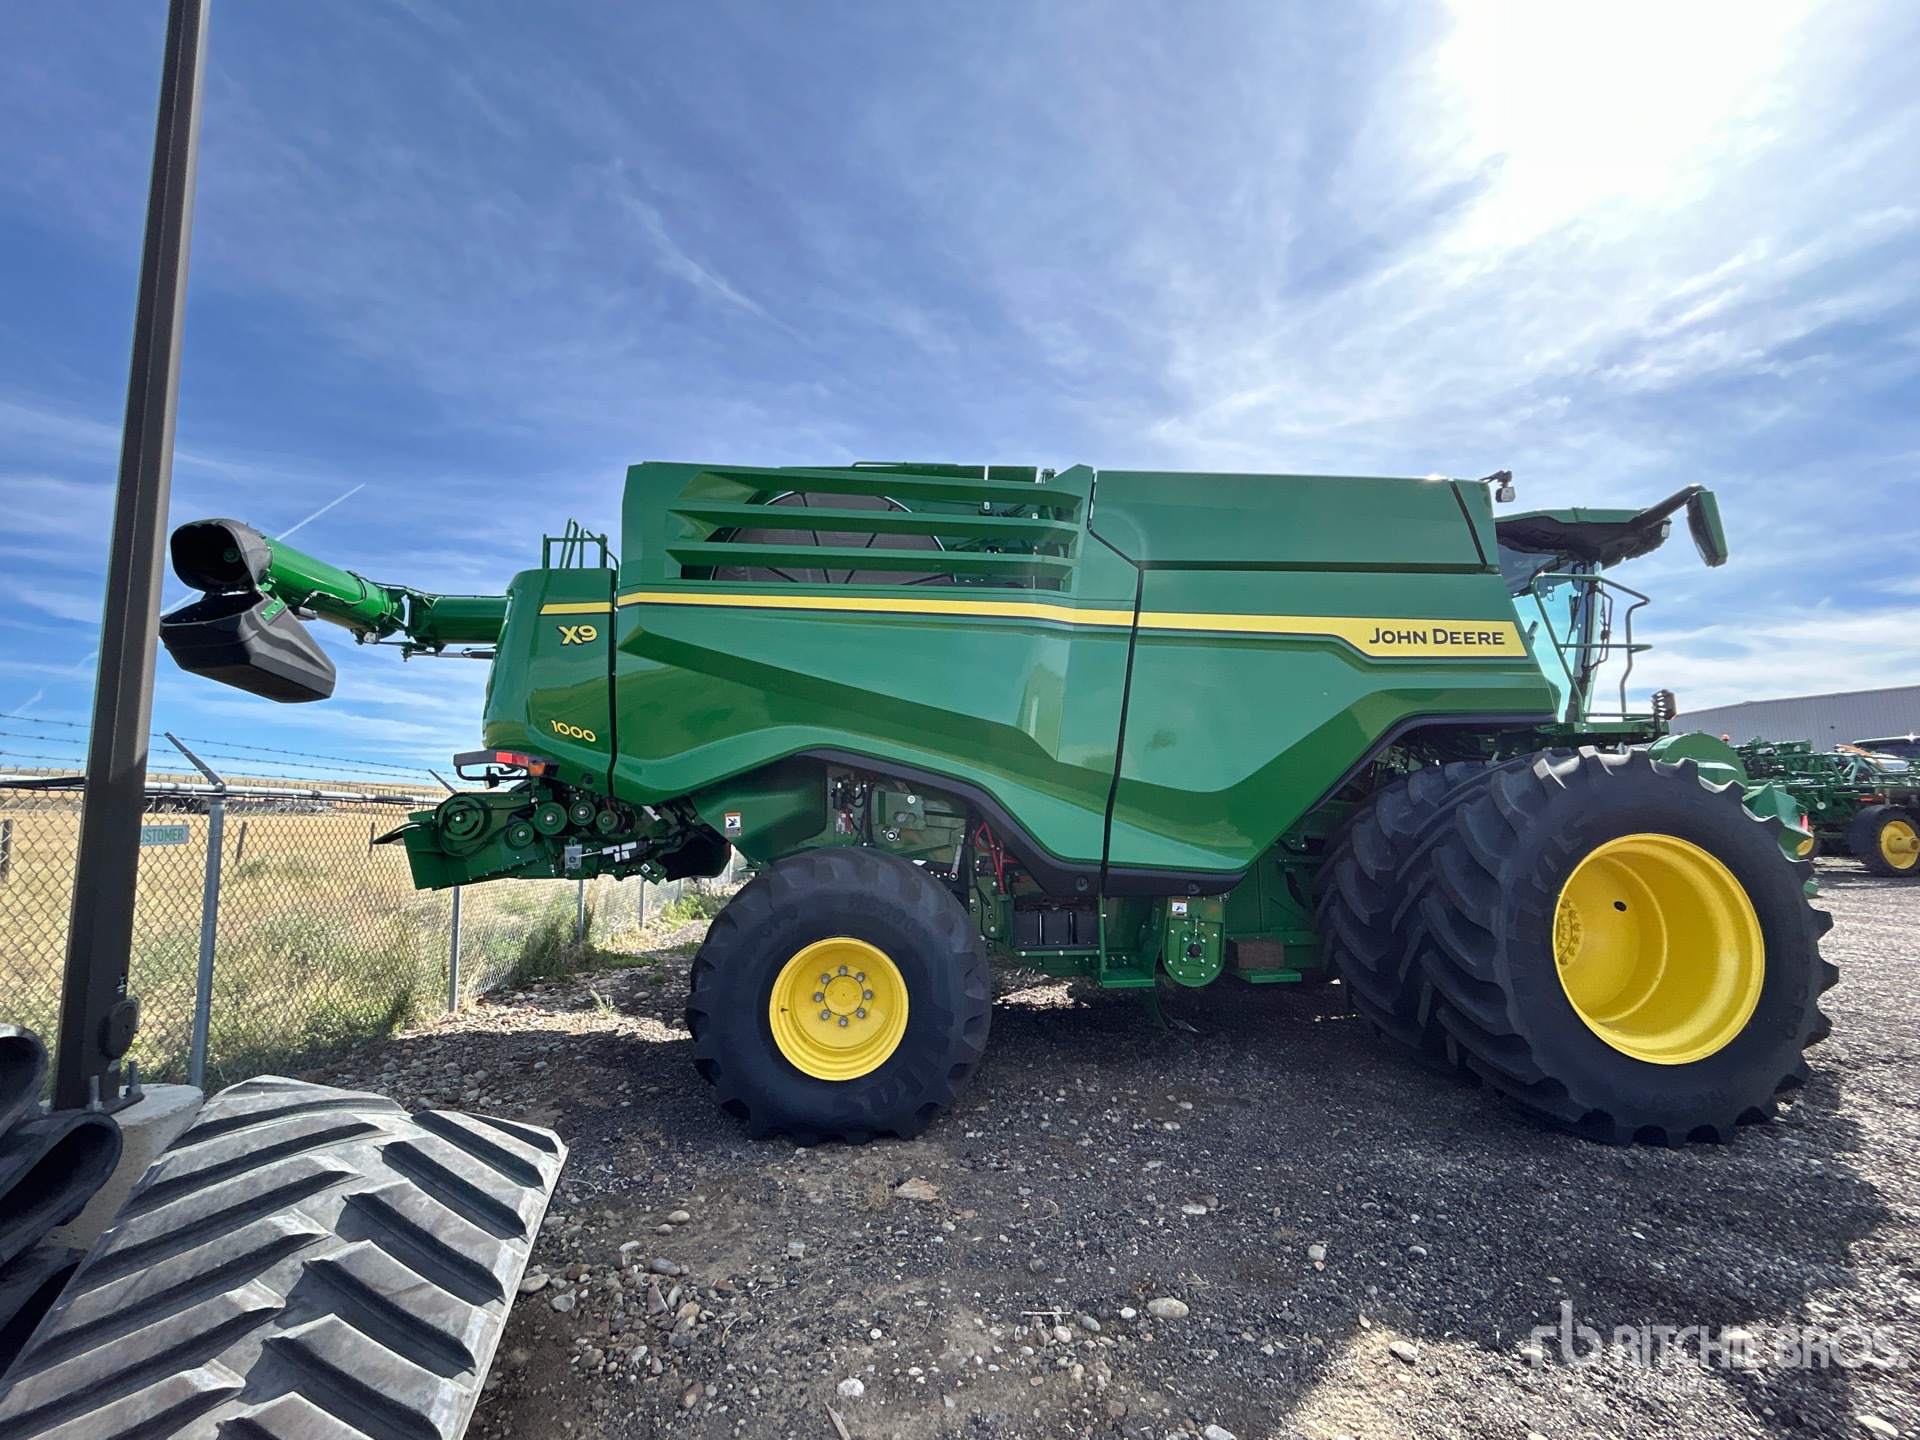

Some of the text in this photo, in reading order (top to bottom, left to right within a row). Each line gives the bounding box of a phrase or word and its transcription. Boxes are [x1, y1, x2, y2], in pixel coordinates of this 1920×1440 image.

[557, 624, 598, 646] X9
[1369, 627, 1505, 645] JOHN DEERE
[550, 719, 597, 743] 1000
[140, 828, 184, 843] USTOMER
